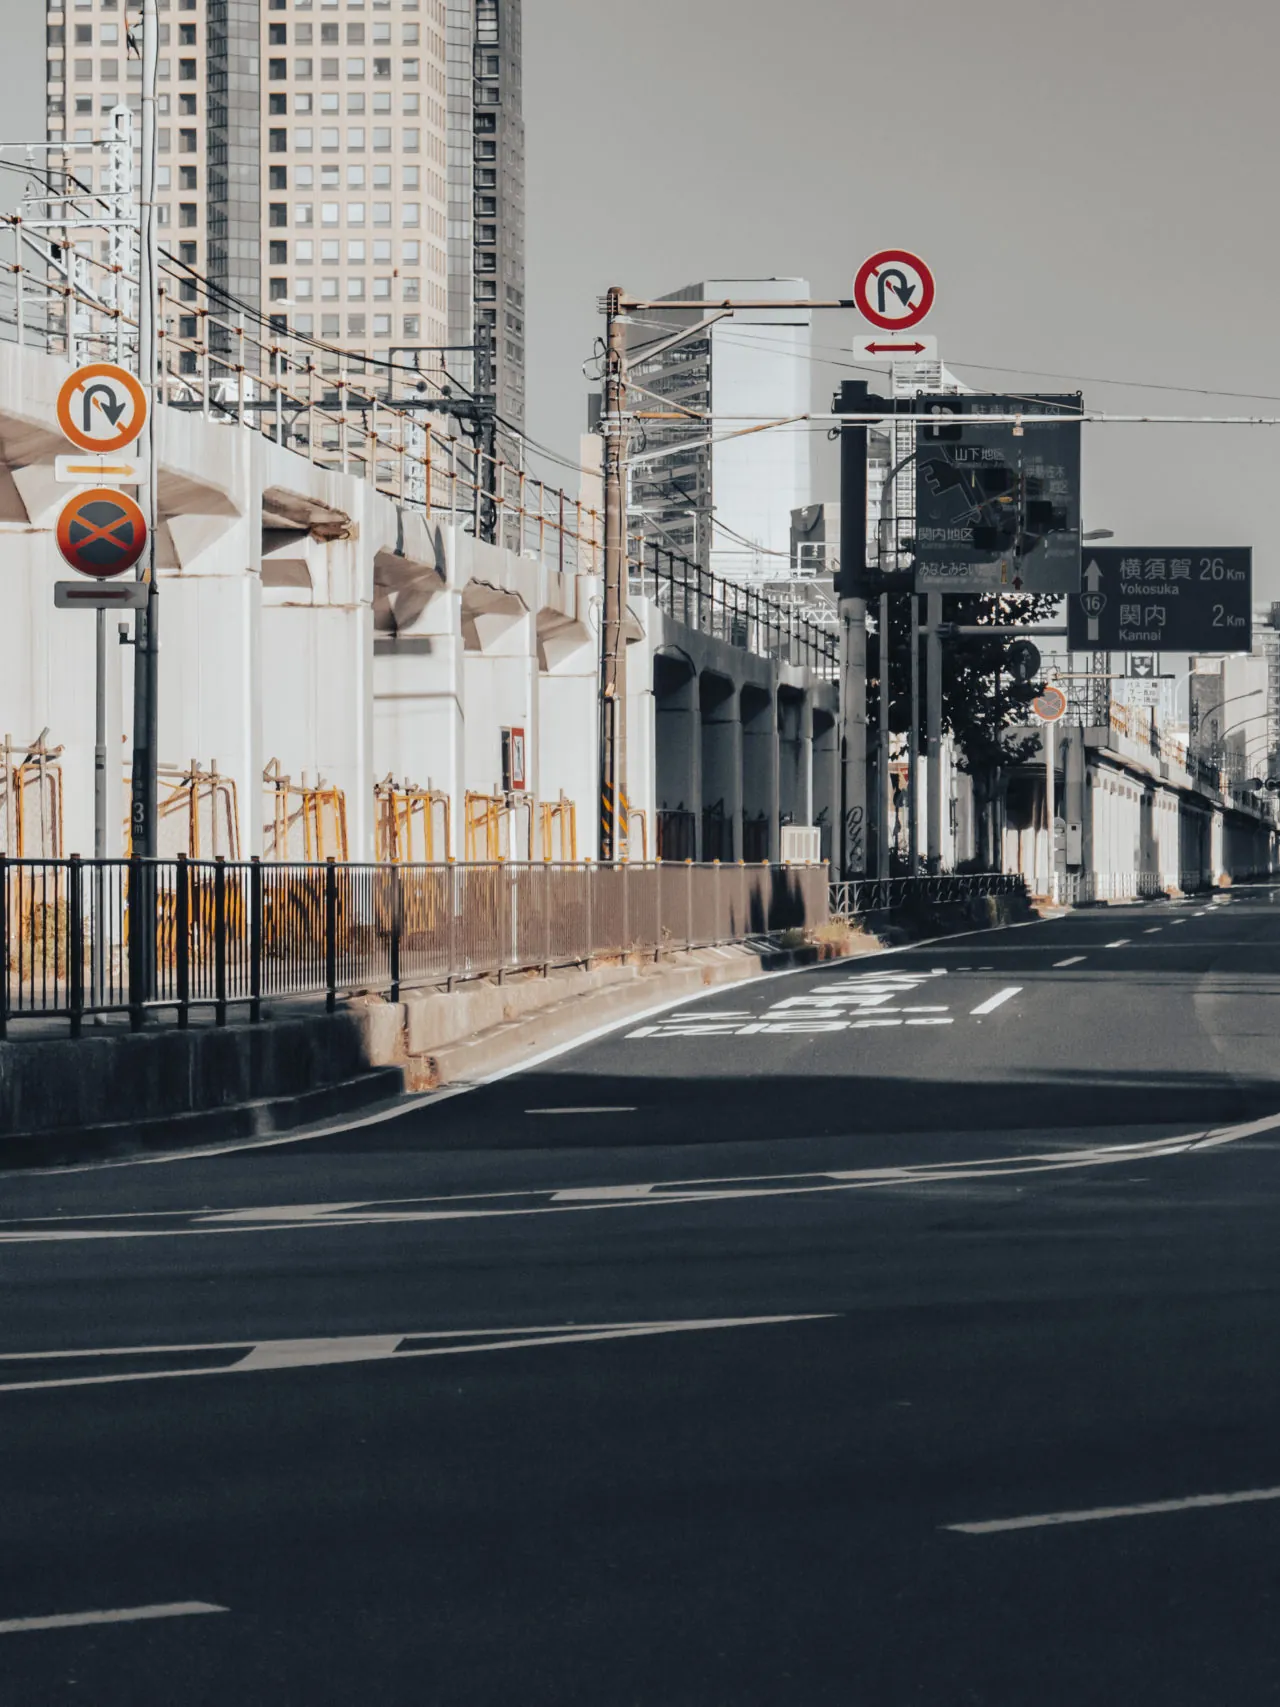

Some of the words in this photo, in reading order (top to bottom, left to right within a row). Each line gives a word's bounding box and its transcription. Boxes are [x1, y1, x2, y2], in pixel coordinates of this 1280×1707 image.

[955, 447, 1005, 461] 山下地区
[918, 527, 975, 541] 関内地区
[1119, 558, 1192, 580] 横須賀
[1199, 558, 1225, 581] 26
[1226, 569, 1246, 581] Km
[1119, 582, 1180, 595] Yokosuka
[1085, 596, 1100, 611] 16
[1119, 604, 1167, 627] 関内
[1212, 604, 1225, 627] 2
[1226, 615, 1246, 627] Km
[1118, 628, 1162, 641] Kannai
